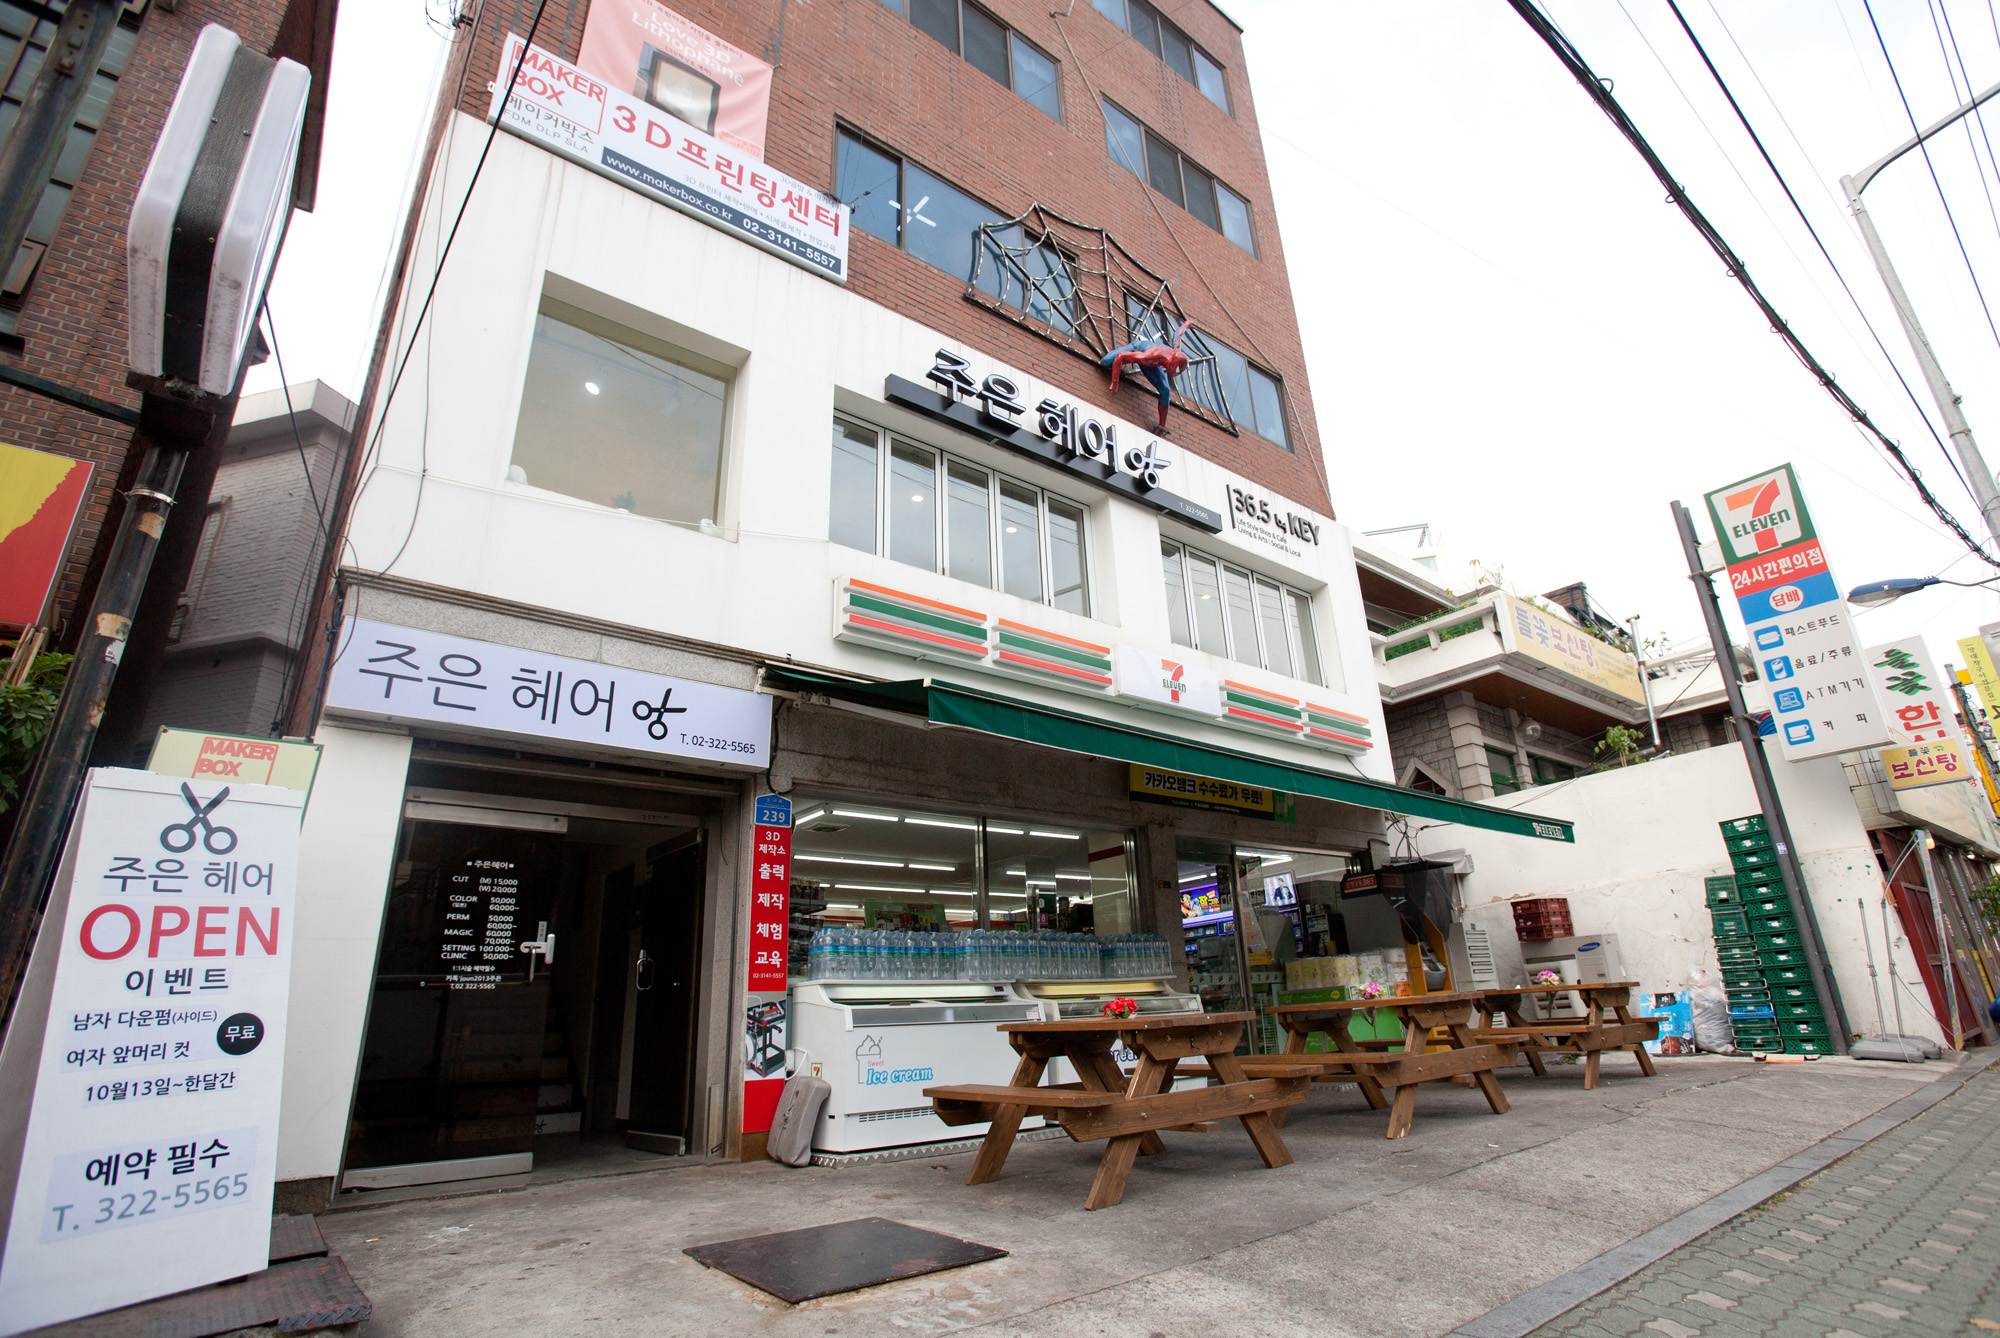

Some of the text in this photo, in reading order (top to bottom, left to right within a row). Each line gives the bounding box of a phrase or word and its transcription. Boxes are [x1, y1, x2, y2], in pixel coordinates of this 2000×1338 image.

[652, 12, 732, 65] Love 3D
[631, 12, 744, 88] Lithophane
[515, 44, 604, 103] MAKER
[509, 66, 565, 106] BOX
[507, 94, 594, 144] 메이커박스
[536, 125, 561, 139] DLP
[564, 138, 589, 153] SLA
[606, 155, 836, 268] www.makerbox.co.kr 02-3141-5557
[926, 348, 1119, 473] 주은 헤어
[1233, 488, 1272, 524] 36.5
[1287, 512, 1320, 546] KEY
[1237, 525, 1253, 539] Living
[1246, 521, 1259, 533] Style
[1259, 526, 1272, 539] Shop
[1731, 547, 1824, 590] 24시간편의점
[1771, 588, 1801, 608] 담배
[1784, 615, 1841, 638] 패스트푸드
[359, 639, 616, 733] 주은 헤어
[203, 739, 276, 761] MAKER
[680, 733, 756, 754] T. 02-322-5565
[197, 758, 243, 777] BOX
[1891, 753, 1958, 781] 보신탕
[1144, 771, 1263, 805] 카카오뱅크 수수료가 무료!
[762, 809, 786, 823] 239
[765, 831, 781, 841] 3D
[758, 843, 786, 856] 제작소
[474, 860, 508, 869] 주은헤어
[758, 862, 785, 880] 출력
[103, 856, 274, 896] 주은 헤어
[479, 877, 491, 885] (M)
[493, 878, 518, 886] 15,000
[490, 897, 516, 905] 50,000
[757, 893, 784, 910] 제작
[79, 903, 280, 961] OPEN
[756, 922, 782, 940] 체험
[442, 944, 476, 952] SETTING
[755, 950, 782, 968] 교육
[125, 967, 229, 997] 이벤트
[73, 1012, 112, 1031] 남자
[225, 1025, 256, 1042] 무료
[66, 1041, 190, 1067] 여자 앞머리 컷
[867, 1059, 885, 1068] Sweet
[866, 1067, 934, 1085] Ice cream
[85, 1138, 230, 1187] 예약 필수
[52, 1172, 249, 1232] T. 322-5565
